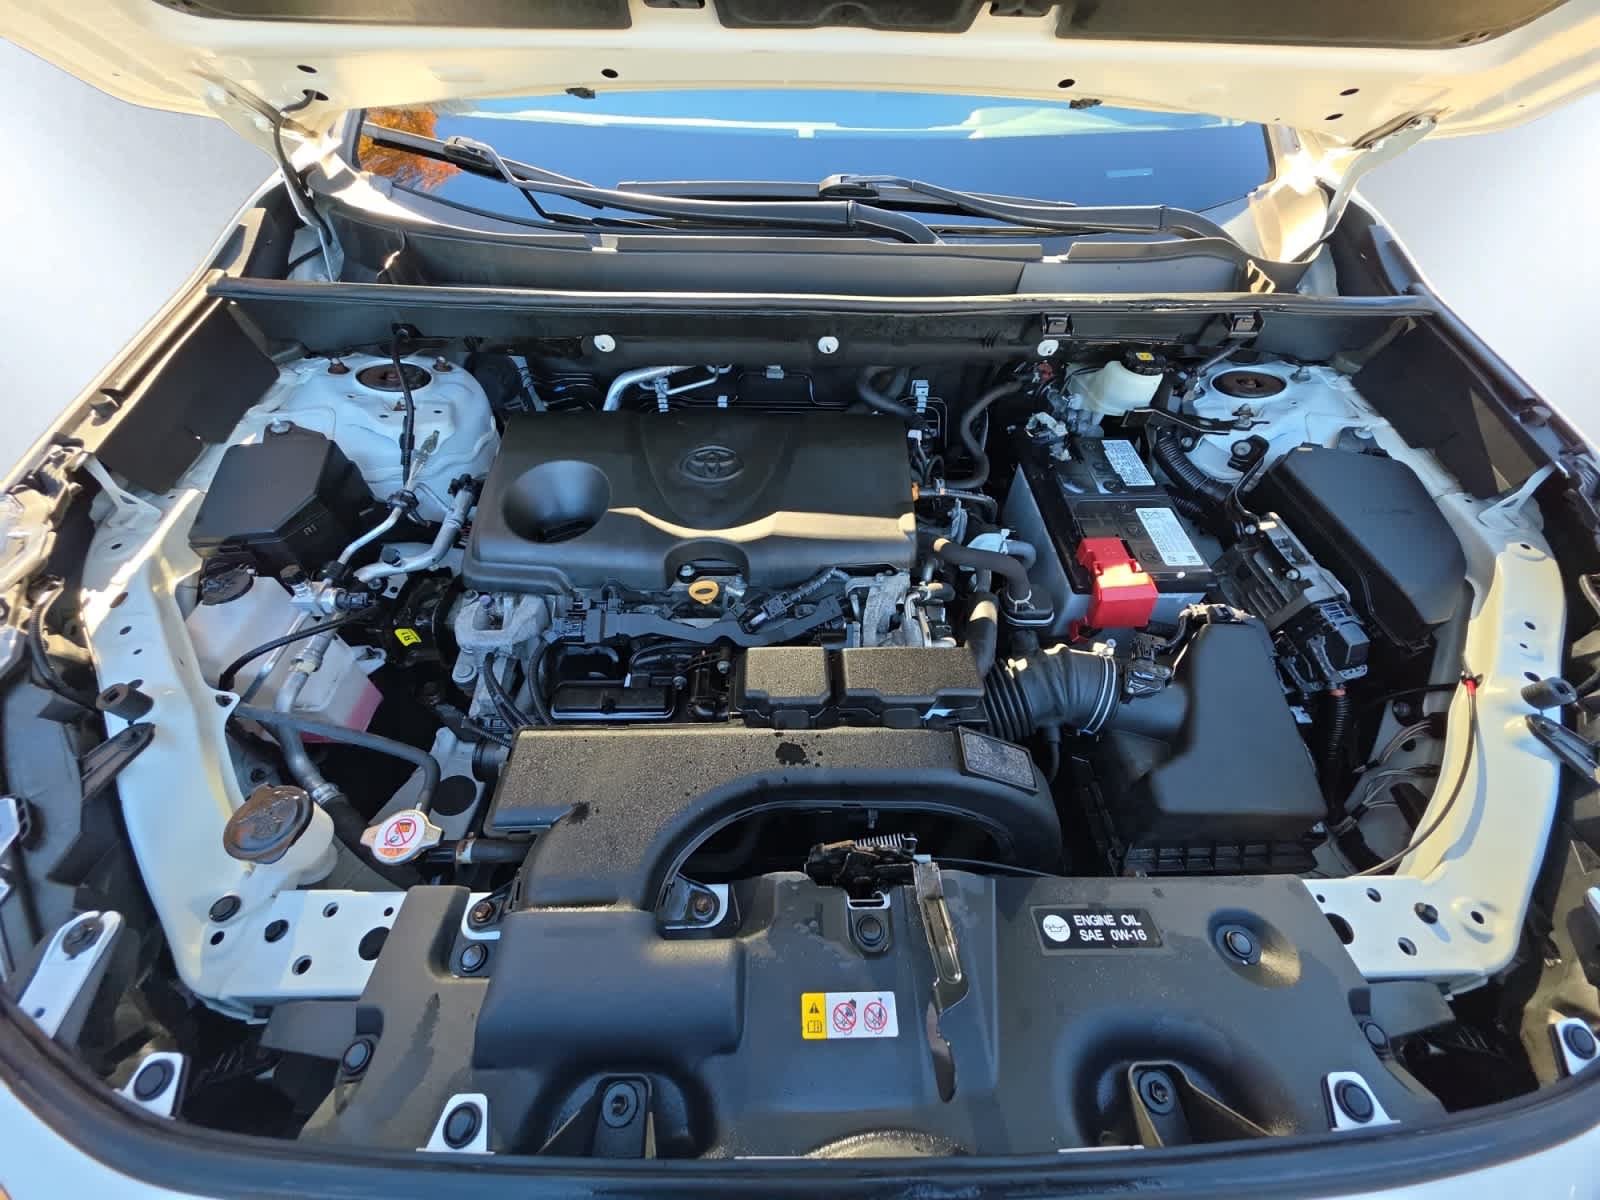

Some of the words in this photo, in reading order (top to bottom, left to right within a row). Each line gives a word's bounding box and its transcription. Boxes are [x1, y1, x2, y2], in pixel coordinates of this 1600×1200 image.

[1073, 914, 1116, 926] ENGINE
[1121, 914, 1142, 926] OIL
[1079, 929, 1104, 941] SAE
[1110, 929, 1147, 941] 0W-16
